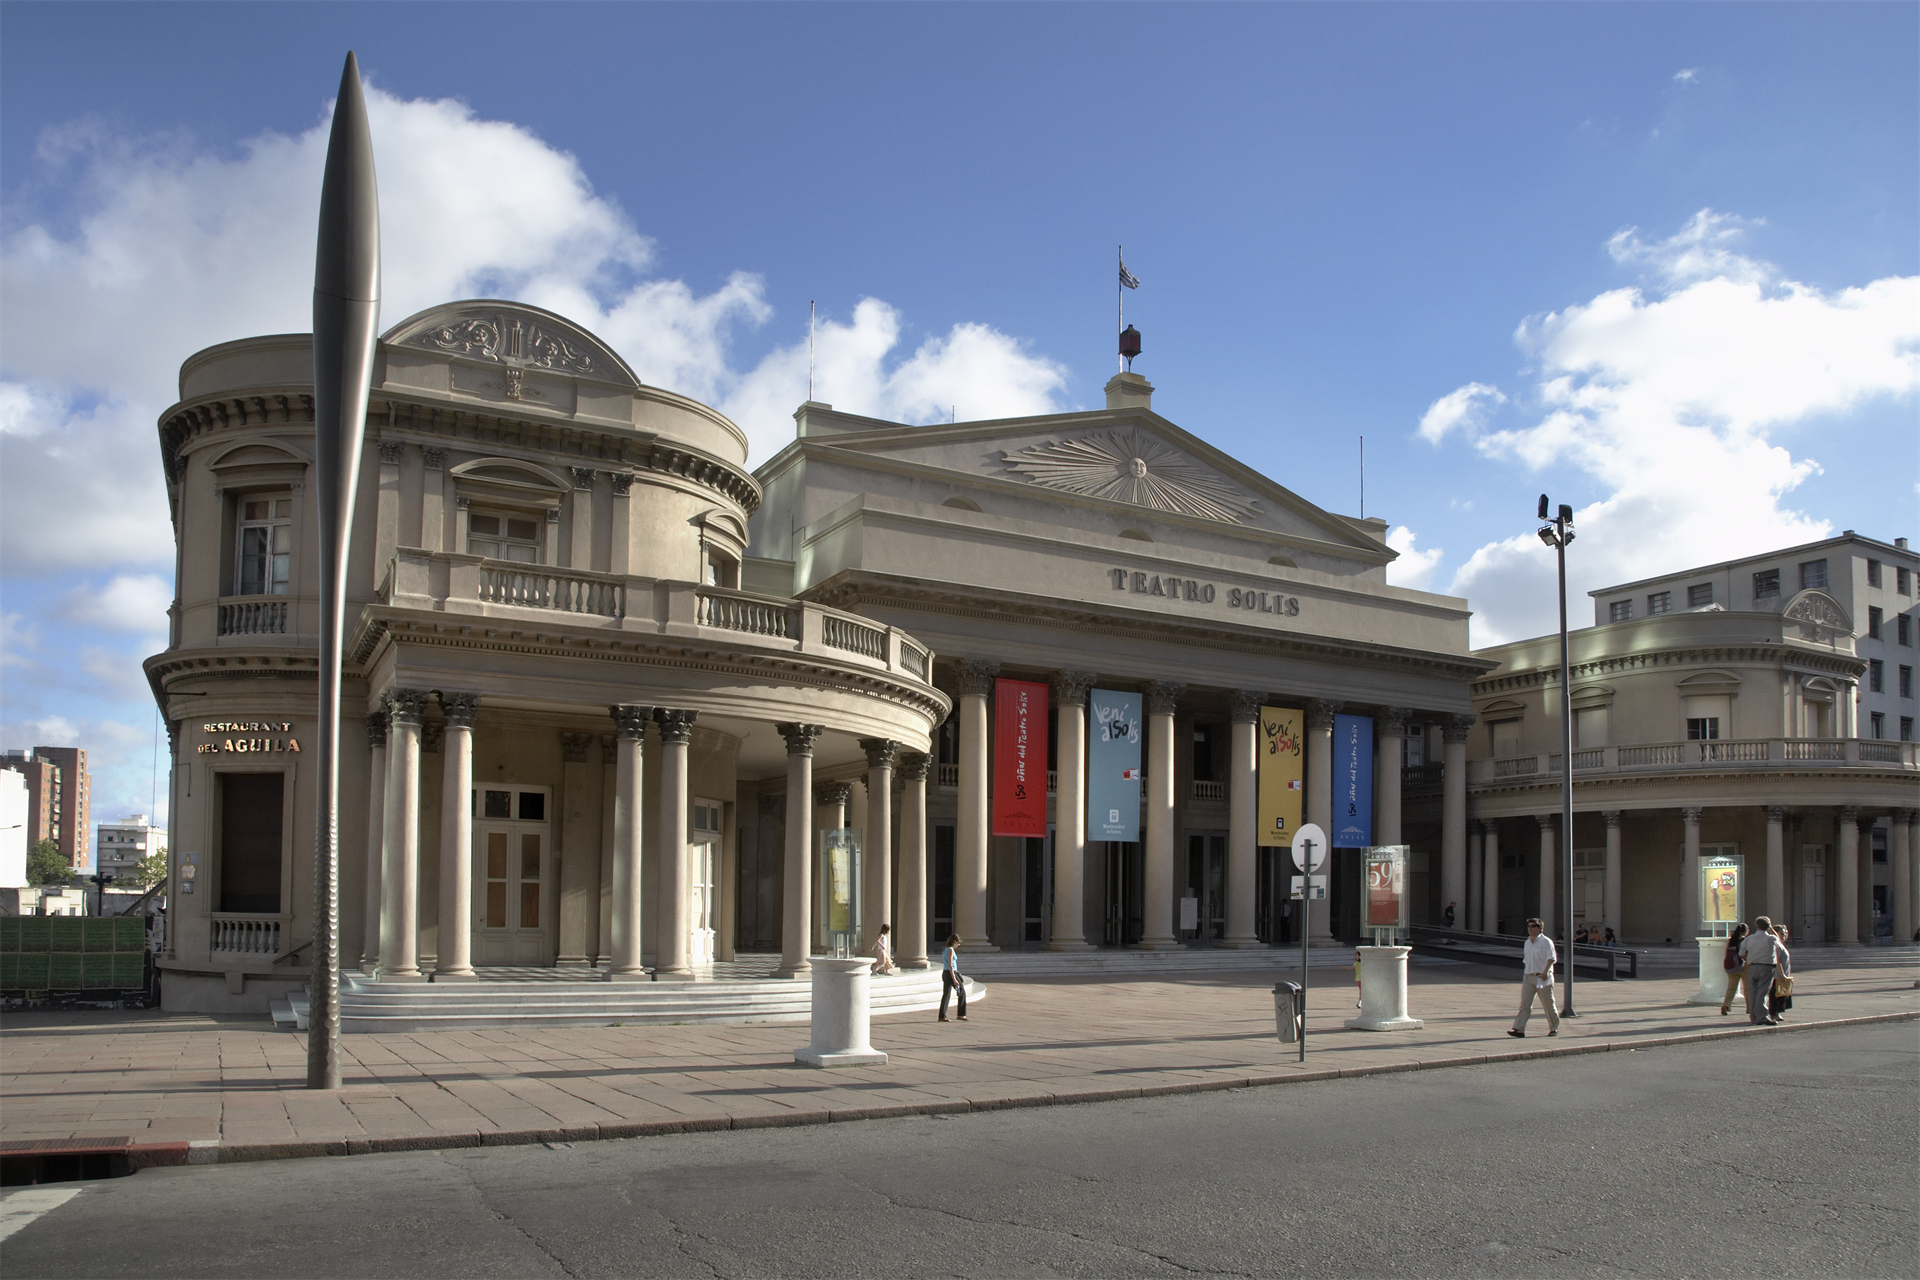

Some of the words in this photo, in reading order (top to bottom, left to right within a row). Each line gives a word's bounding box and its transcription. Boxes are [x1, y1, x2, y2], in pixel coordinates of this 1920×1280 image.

[1112, 568, 1216, 604] TEATRO
[1230, 587, 1301, 617] SOLIS
[203, 722, 292, 733] RESTAURANT
[1017, 718, 1028, 744] Teatro
[197, 743, 219, 754] DEL
[224, 738, 301, 753] AGUILA
[1016, 745, 1027, 759] del
[1015, 784, 1027, 800] 150
